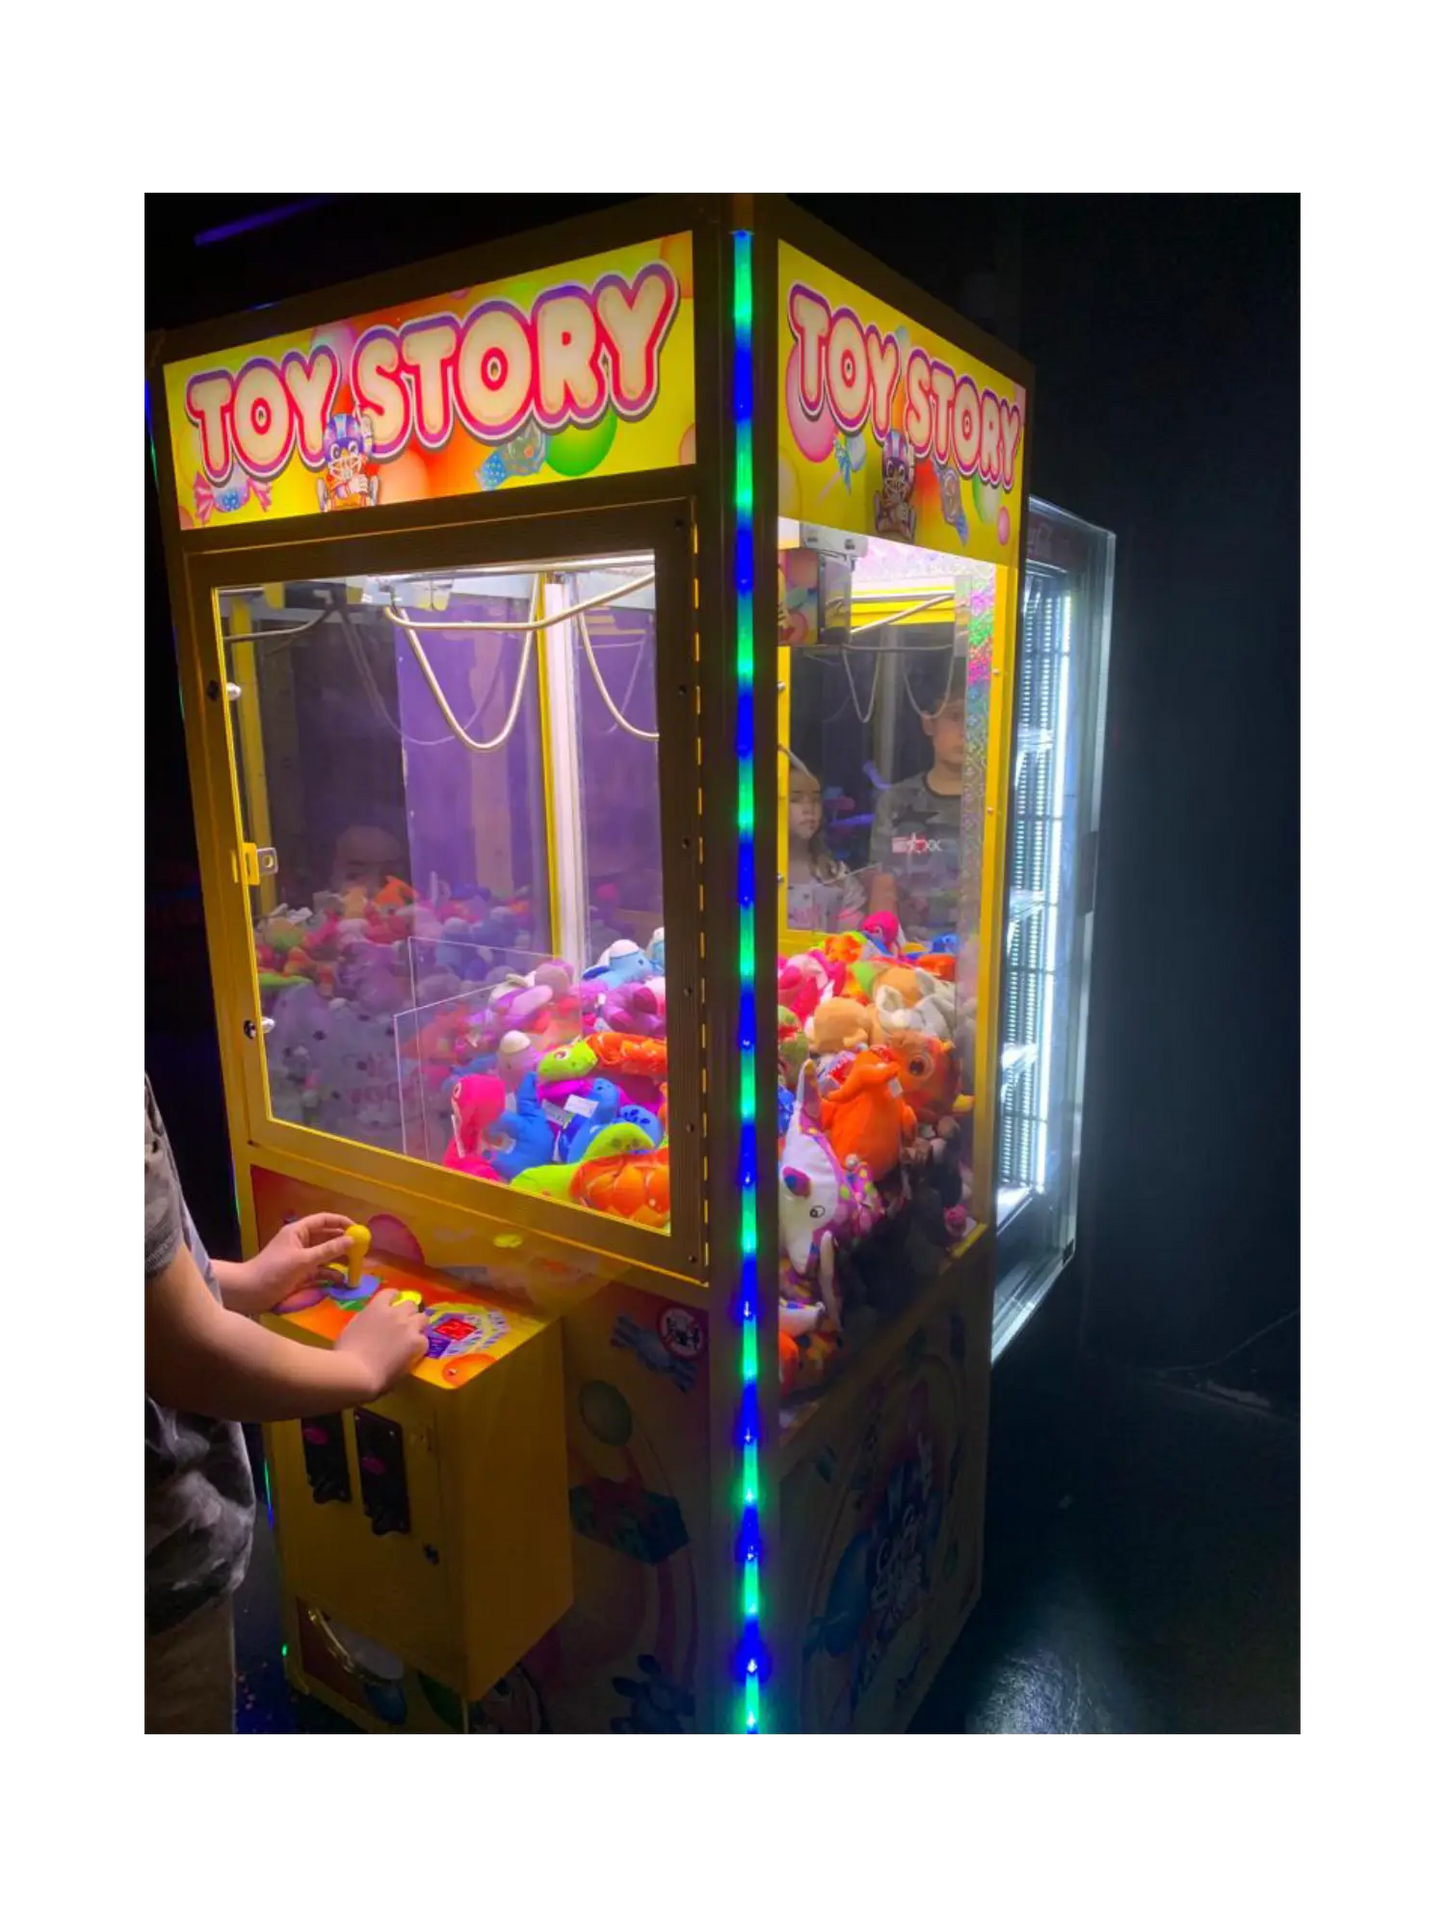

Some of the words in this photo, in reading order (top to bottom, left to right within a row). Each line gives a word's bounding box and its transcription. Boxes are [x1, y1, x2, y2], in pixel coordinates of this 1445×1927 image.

[187, 346, 338, 482] TOY
[352, 263, 678, 458] STORY
[788, 283, 900, 440] TOY
[904, 349, 1021, 489] STORY
